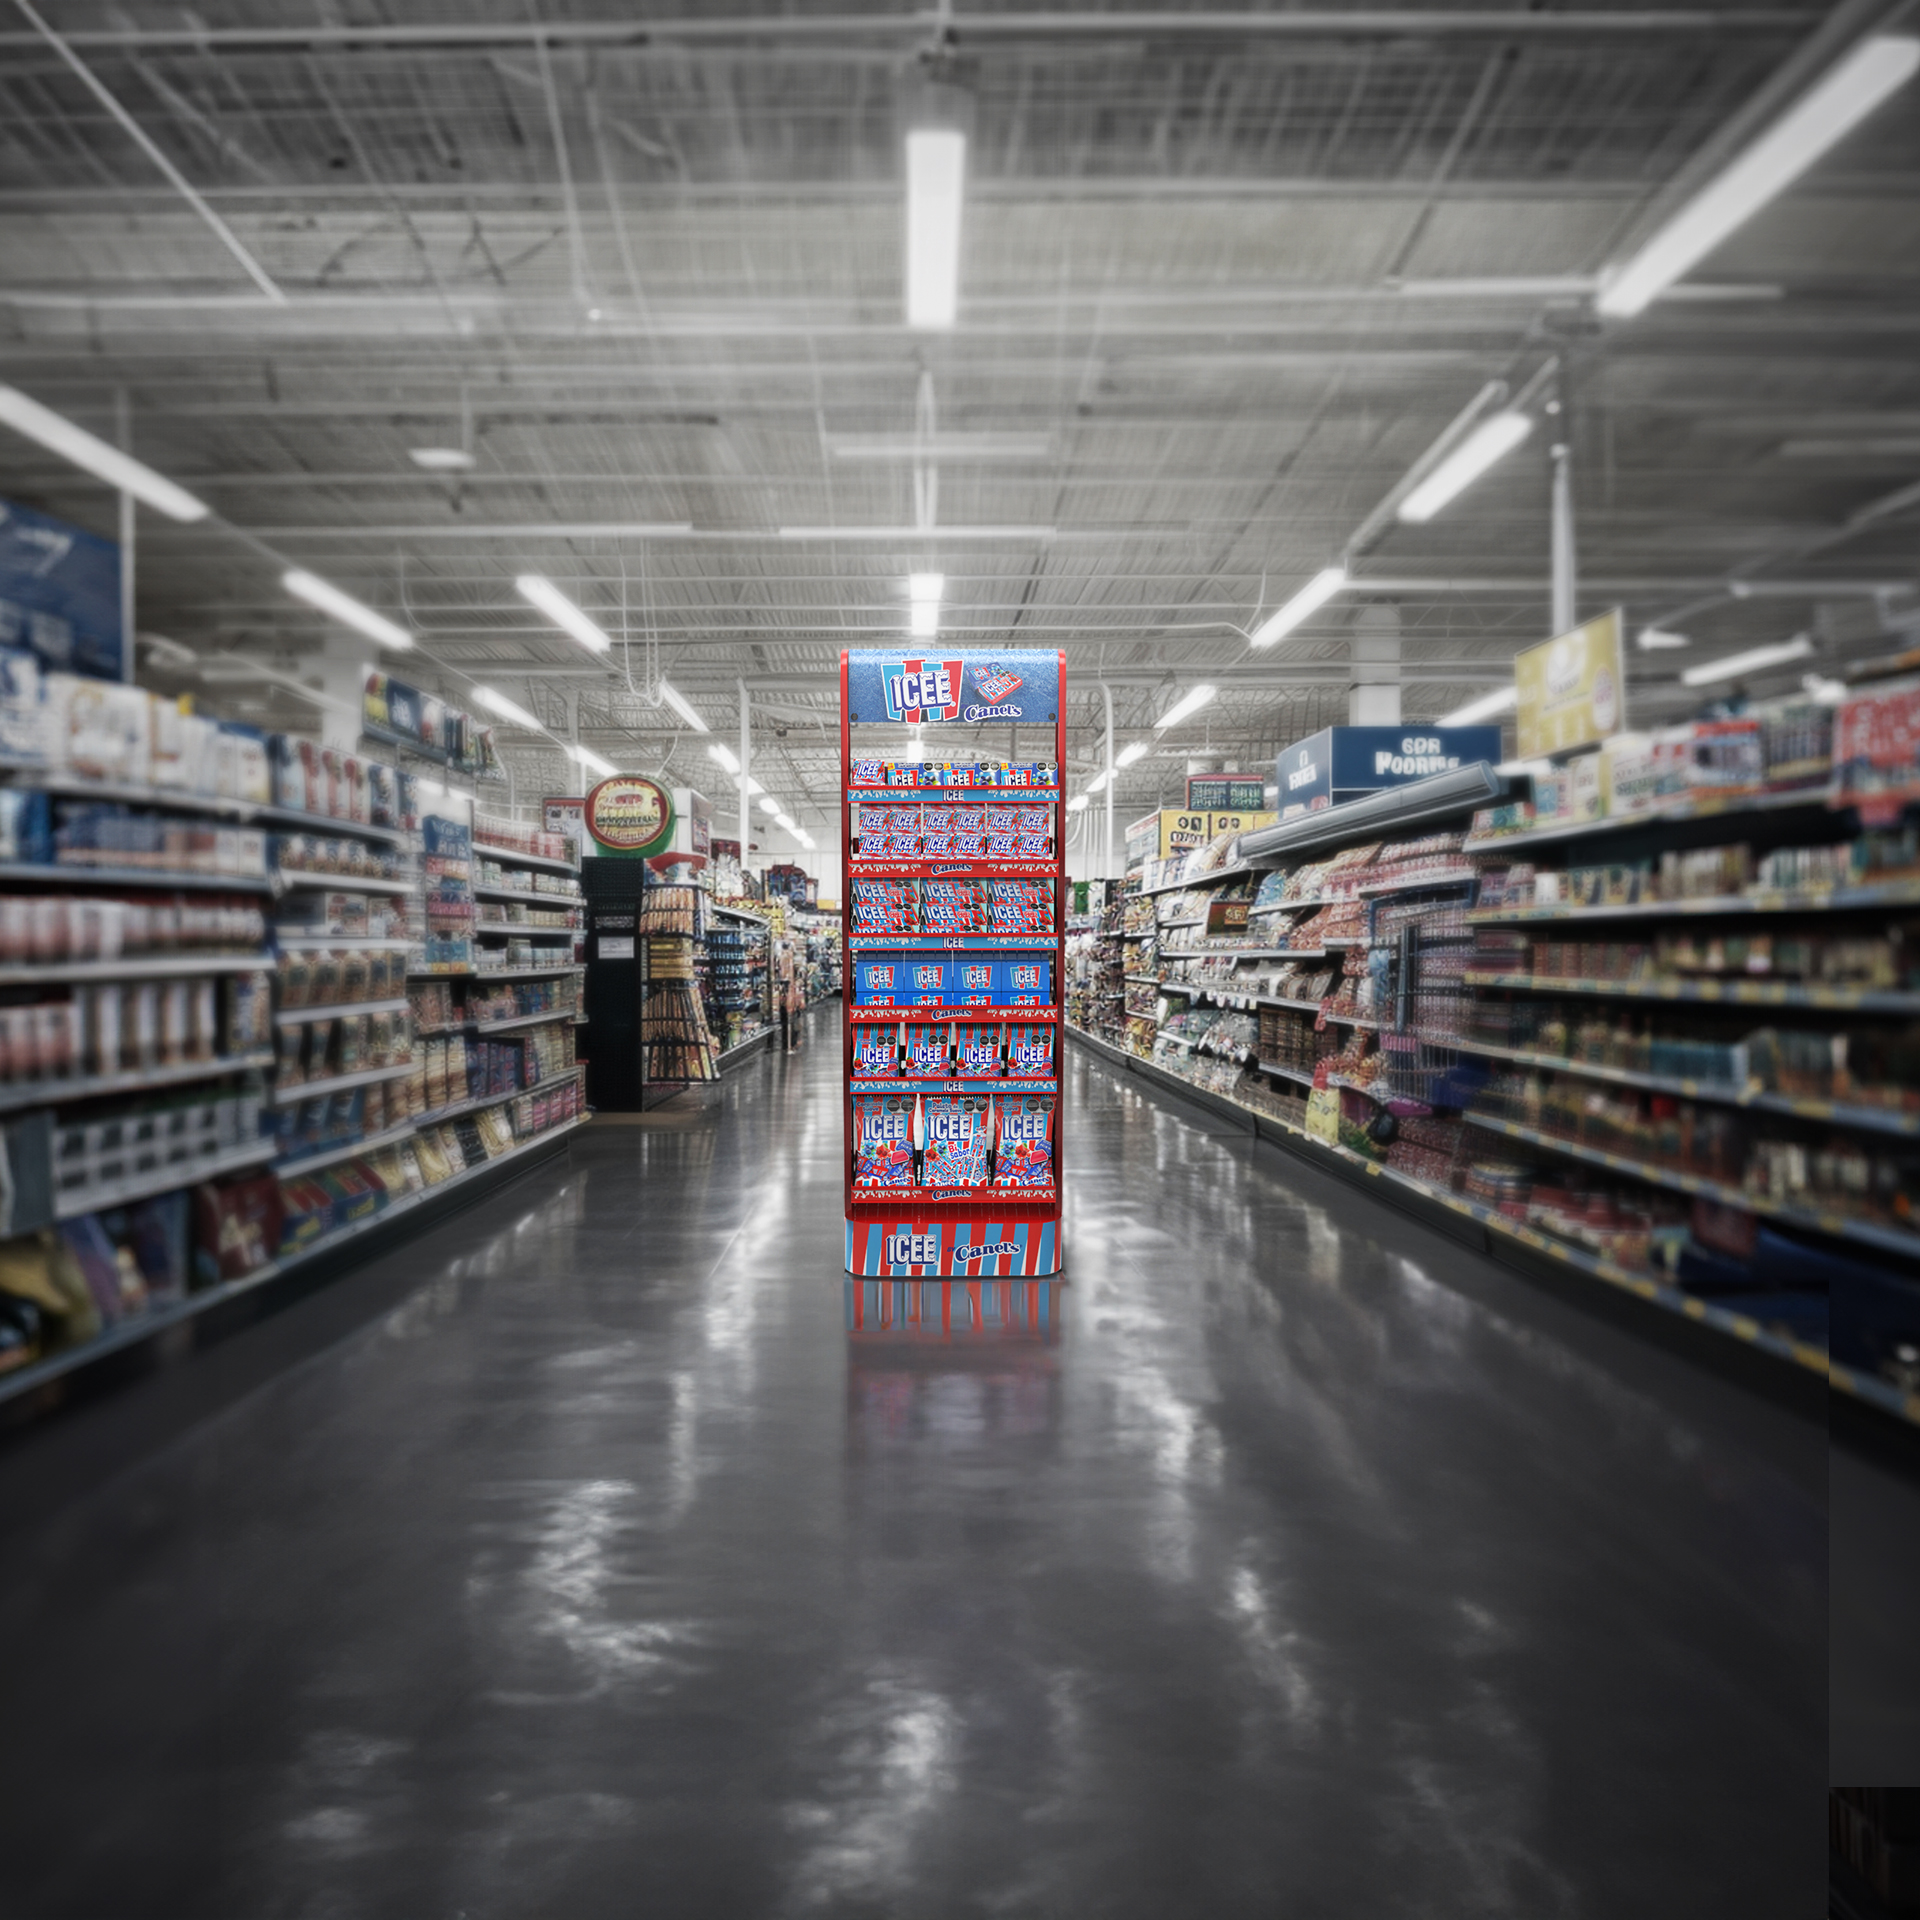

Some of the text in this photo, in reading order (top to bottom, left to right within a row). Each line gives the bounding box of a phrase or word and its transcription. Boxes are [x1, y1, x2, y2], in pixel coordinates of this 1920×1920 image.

[890, 669, 953, 712] ICEE
[982, 680, 1002, 695] ICEE
[857, 762, 878, 776] ICEE
[943, 790, 963, 801] ICEE
[863, 814, 883, 827] ICEE
[894, 814, 915, 827] ICEE
[927, 814, 947, 827] ICEE
[958, 814, 978, 827] ICEE
[991, 814, 1011, 827] ICEE
[1022, 814, 1042, 827] ICEE
[863, 837, 883, 850] ICEE
[894, 837, 915, 850] ICEE
[927, 837, 947, 850] ICEE
[958, 837, 978, 850] ICEE
[991, 837, 1011, 850] ICEE
[1022, 837, 1042, 850] ICEE
[857, 884, 887, 898] ICEE
[925, 884, 955, 898] ICEE
[992, 884, 1023, 898] ICEE
[857, 906, 887, 920] ICEE
[925, 906, 955, 920] ICEE
[992, 906, 1023, 920] ICEE
[943, 937, 964, 948] ICEE
[868, 970, 890, 984] ICEE
[917, 970, 939, 984] ICEE
[966, 970, 987, 984] ICEE
[1014, 970, 1036, 984] ICEE
[862, 1047, 890, 1064] ICEE
[914, 1047, 942, 1063] ICEE
[965, 1048, 993, 1064] ICEE
[1017, 1047, 1045, 1063] ICEE
[943, 1081, 964, 1092] ICEE
[863, 1115, 904, 1140] ICEE
[928, 1115, 970, 1141] ICEE
[1003, 1115, 1044, 1140] ICEE
[948, 1144, 957, 1153] Bi
[950, 1148, 970, 1159] sabor
[886, 1234, 936, 1265] ICEE
[955, 1242, 1020, 1262] Canel's
